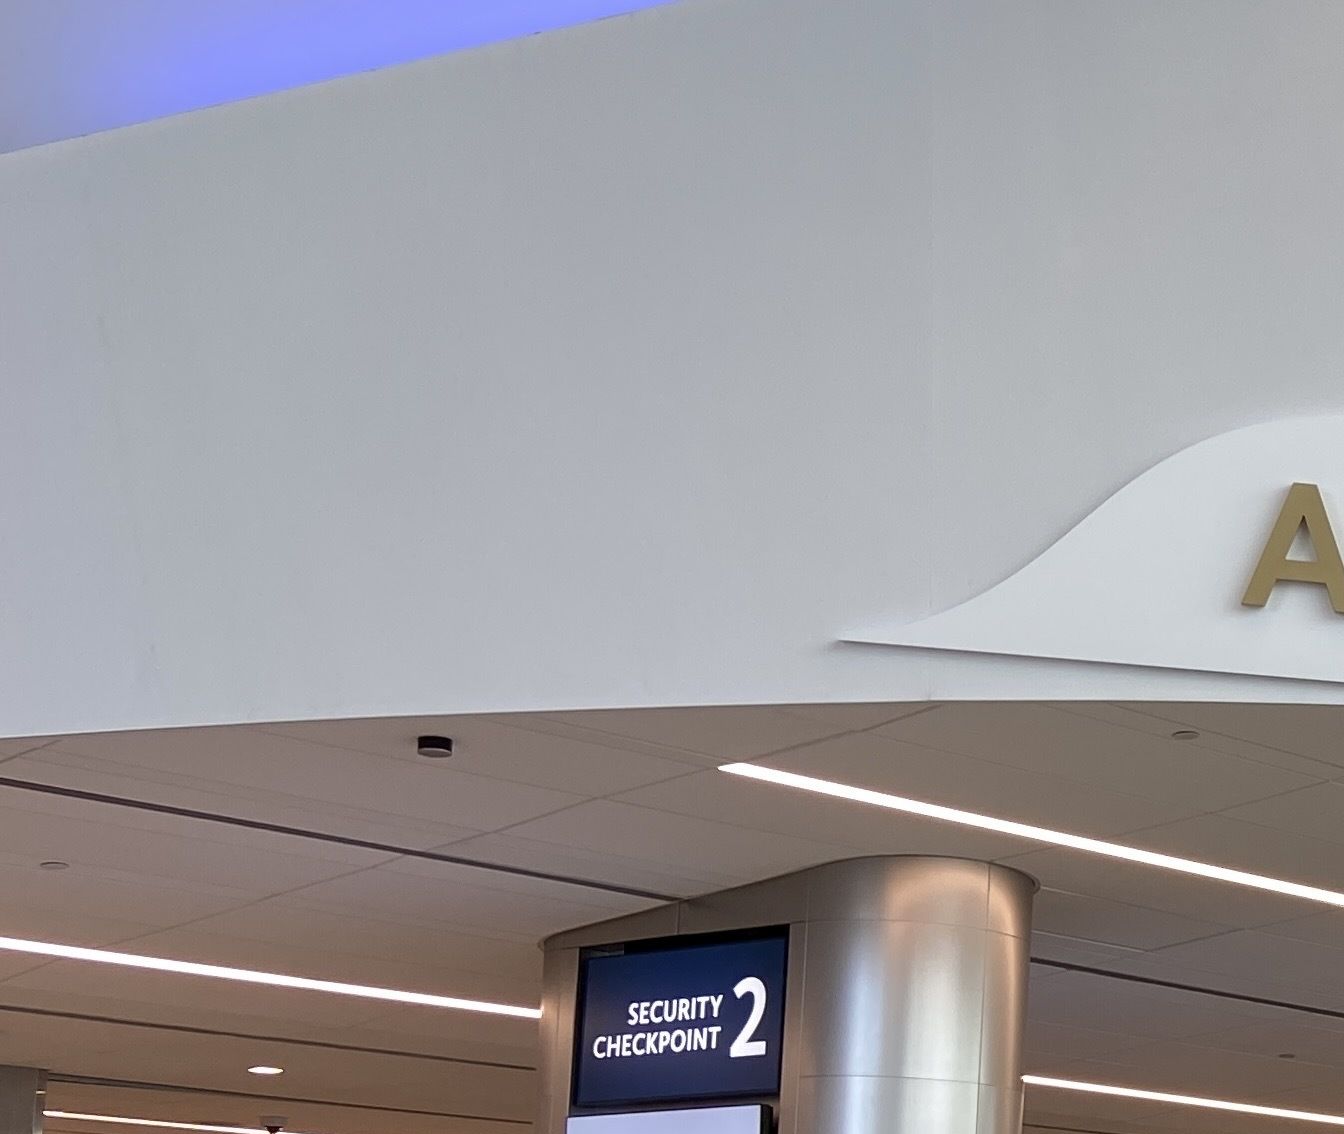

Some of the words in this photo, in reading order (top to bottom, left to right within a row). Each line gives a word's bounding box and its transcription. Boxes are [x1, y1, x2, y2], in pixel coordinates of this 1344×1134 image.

[627, 994, 724, 1026] SECURITY
[729, 976, 767, 1058] 2
[592, 1026, 722, 1059] CHECKPOINT
